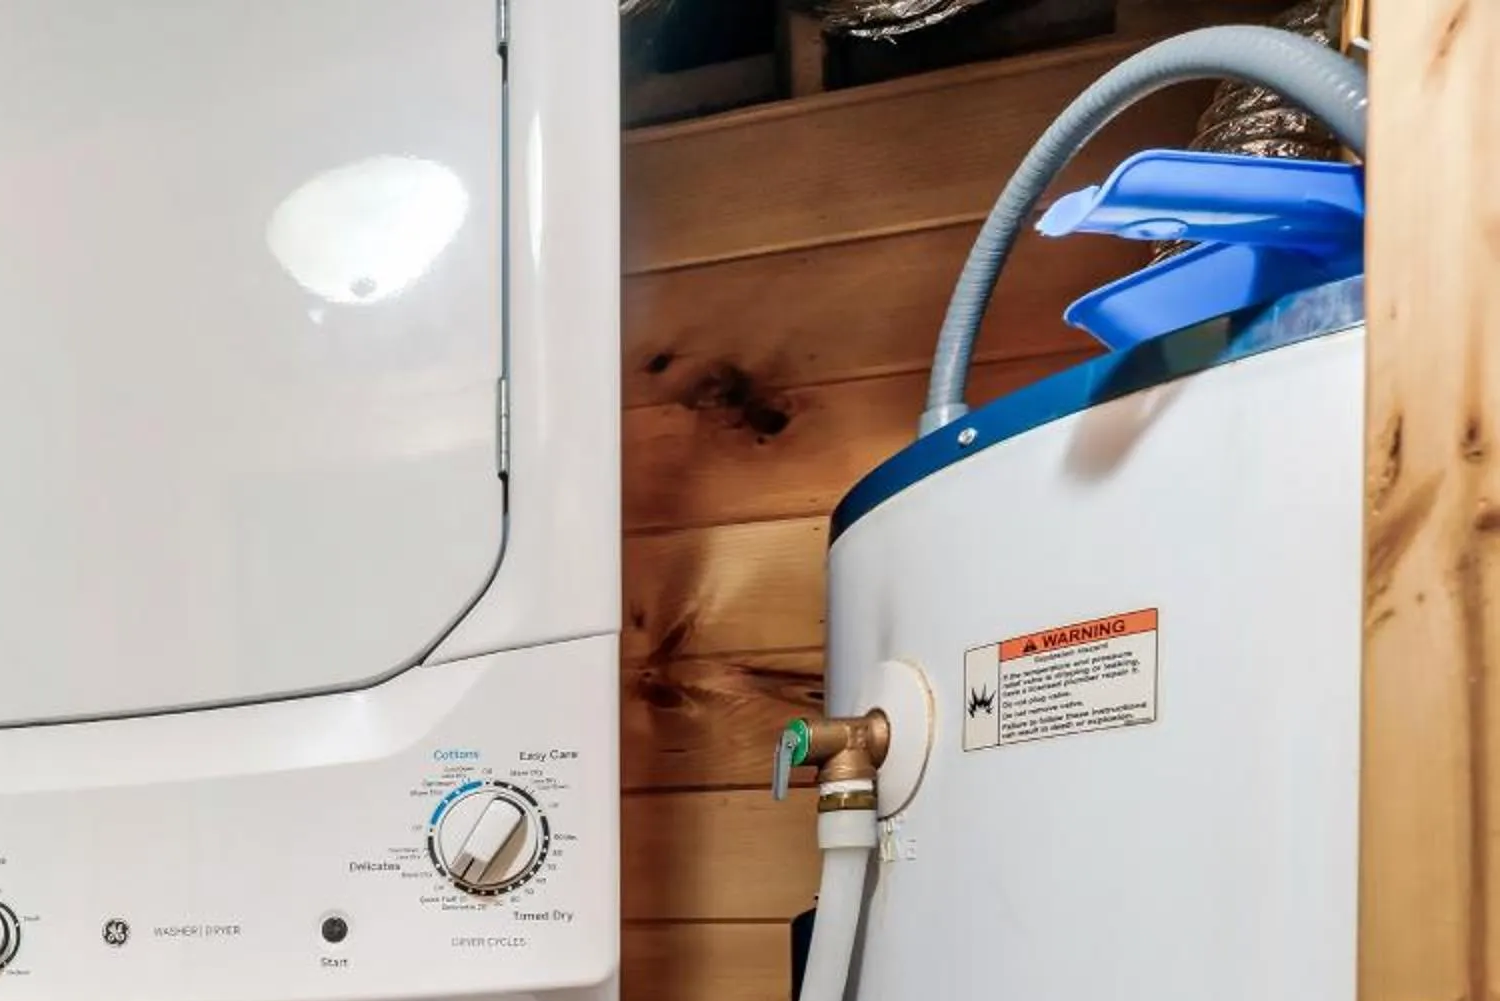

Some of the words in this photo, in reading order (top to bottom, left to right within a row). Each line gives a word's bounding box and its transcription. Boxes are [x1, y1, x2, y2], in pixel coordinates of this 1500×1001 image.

[1043, 619, 1125, 648] WARNING
[434, 750, 479, 760] Cottons
[519, 750, 546, 762] Easy
[549, 749, 578, 760] Care
[349, 860, 402, 873] Delicates
[514, 910, 549, 921] Timed
[552, 909, 573, 923] Dry
[319, 956, 349, 968] Start
